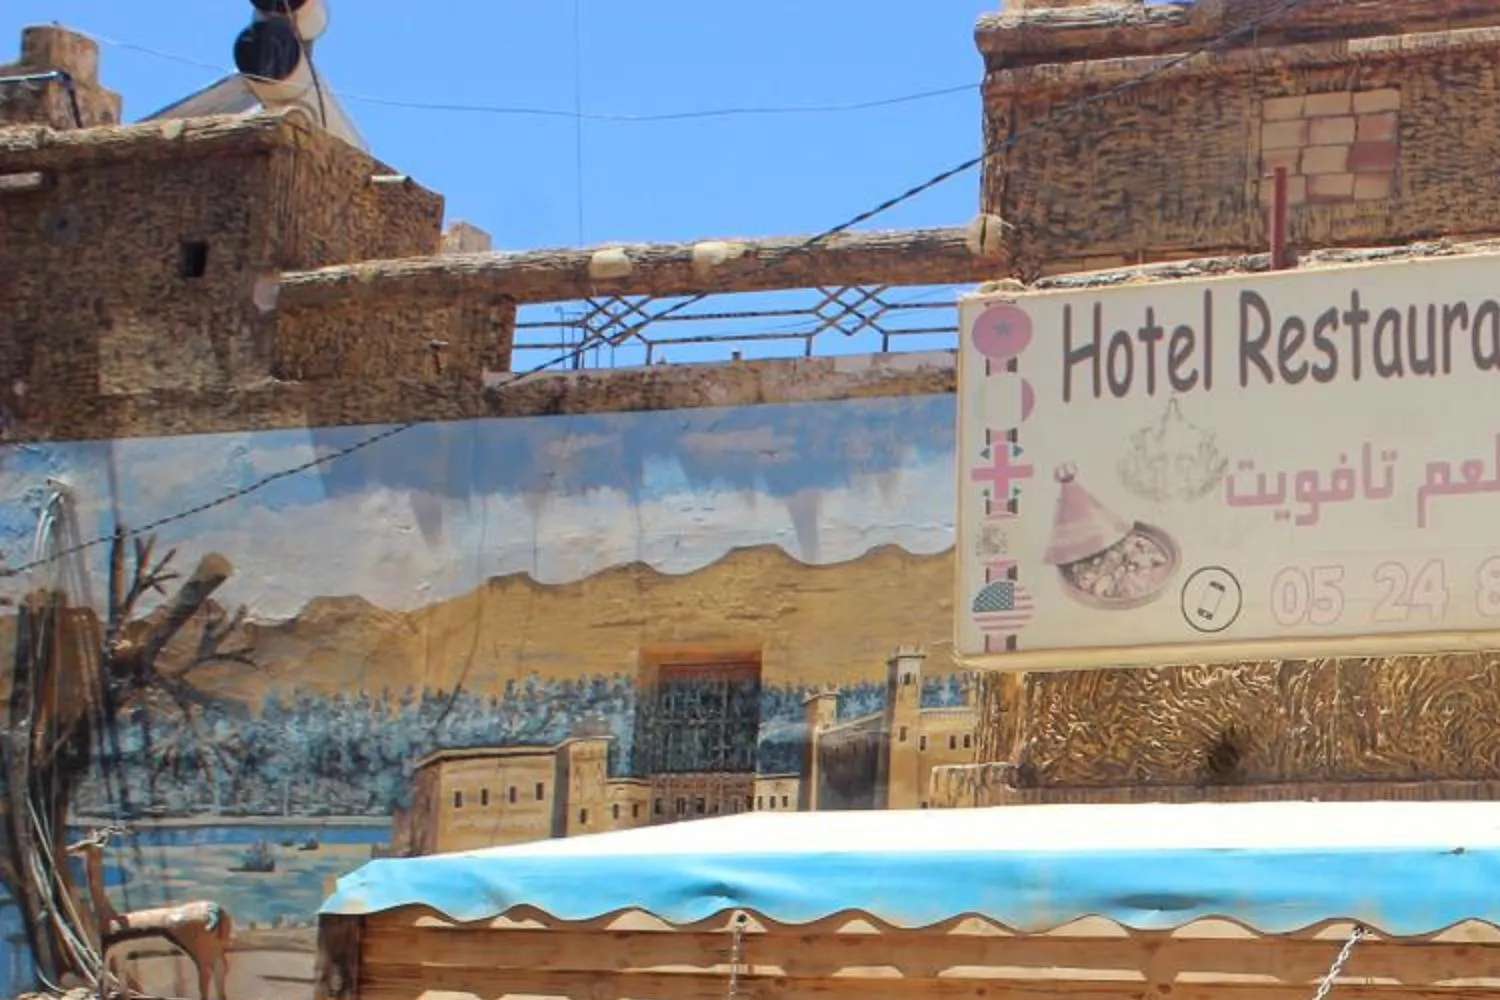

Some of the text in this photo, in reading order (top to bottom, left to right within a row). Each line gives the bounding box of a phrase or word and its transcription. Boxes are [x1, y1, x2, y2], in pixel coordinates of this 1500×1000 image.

[1063, 288, 1212, 402] Hotel
[1226, 442, 1398, 527] تافويت
[1270, 565, 1345, 627] 05
[1371, 558, 1451, 624] 24
